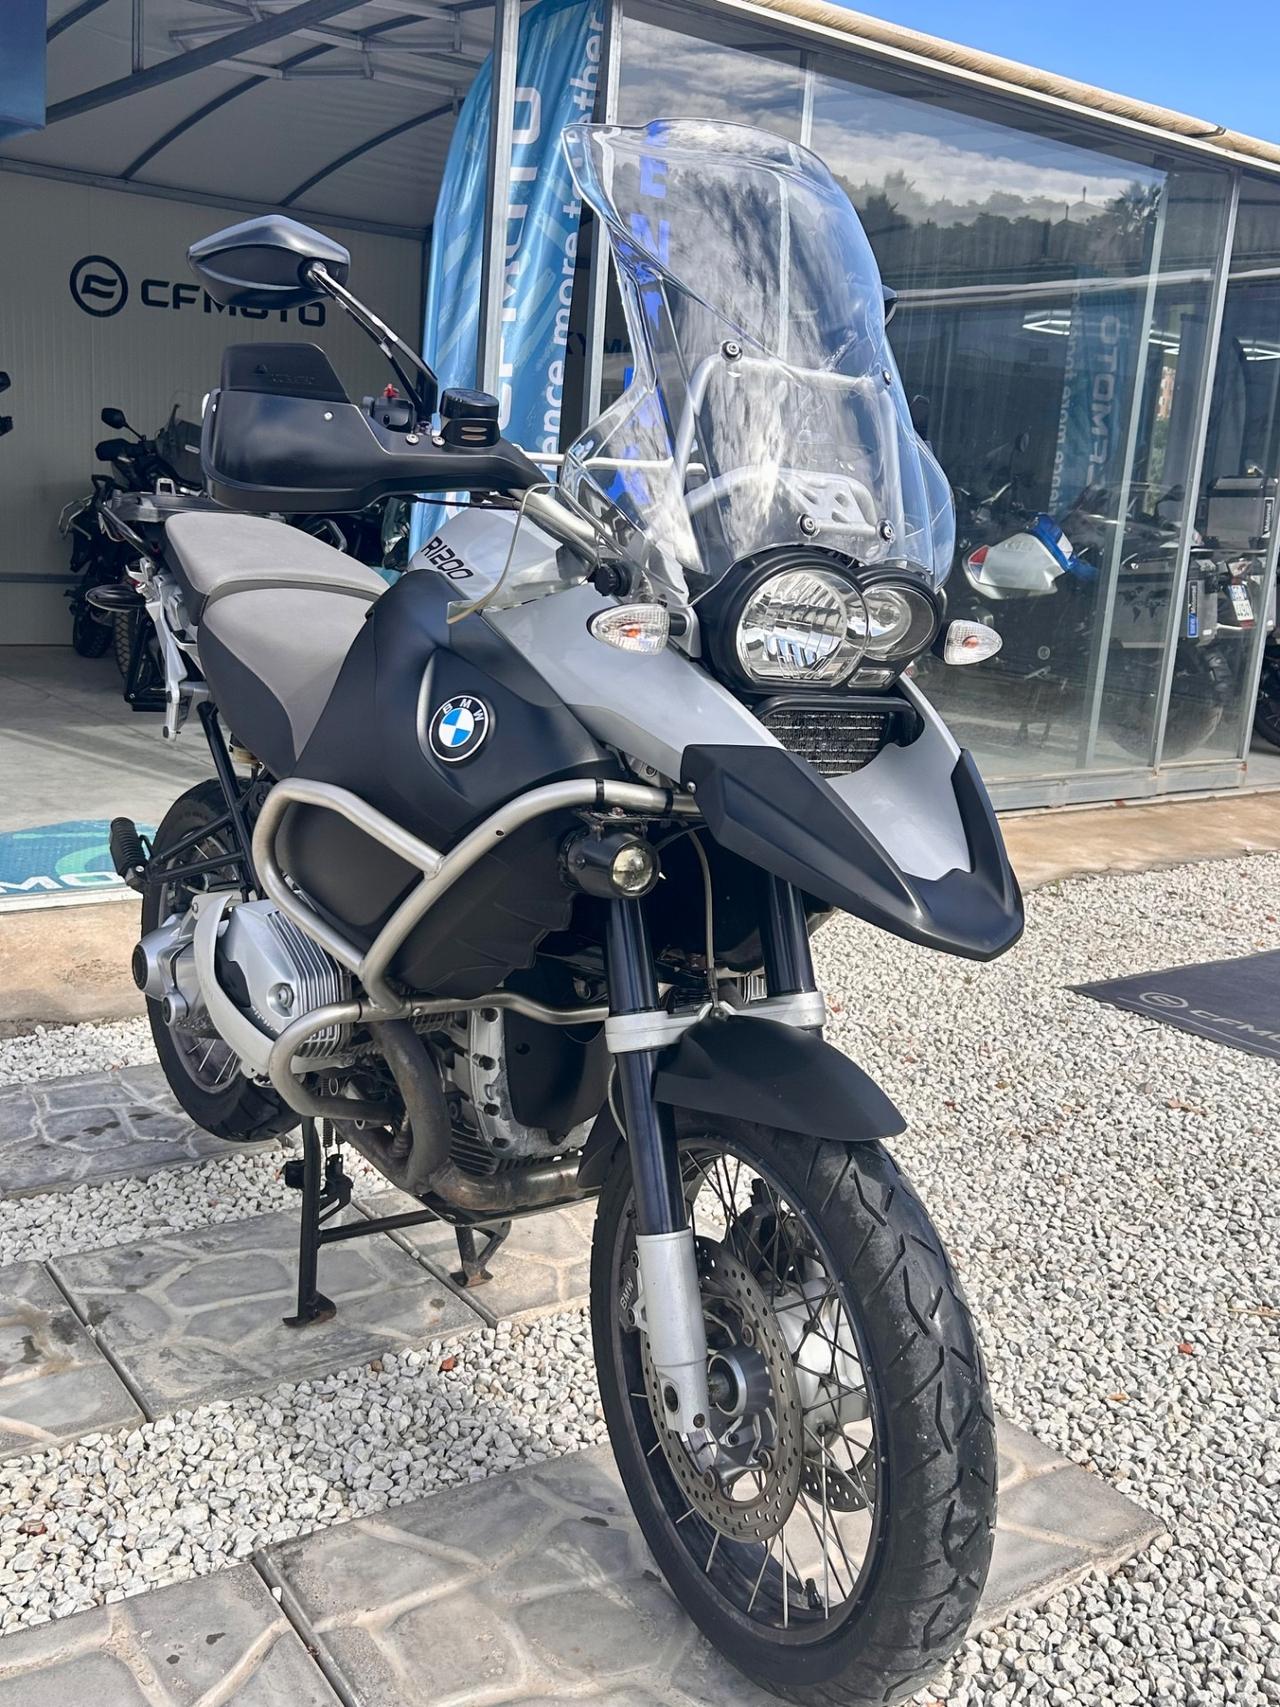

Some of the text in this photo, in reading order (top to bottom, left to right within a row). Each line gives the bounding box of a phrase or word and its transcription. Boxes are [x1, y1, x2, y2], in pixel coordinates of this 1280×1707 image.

[563, 13, 604, 219] toether
[552, 232, 578, 346] more
[420, 536, 474, 580] R1200
[442, 698, 484, 722] BMW
[620, 1277, 634, 1311] BMW
